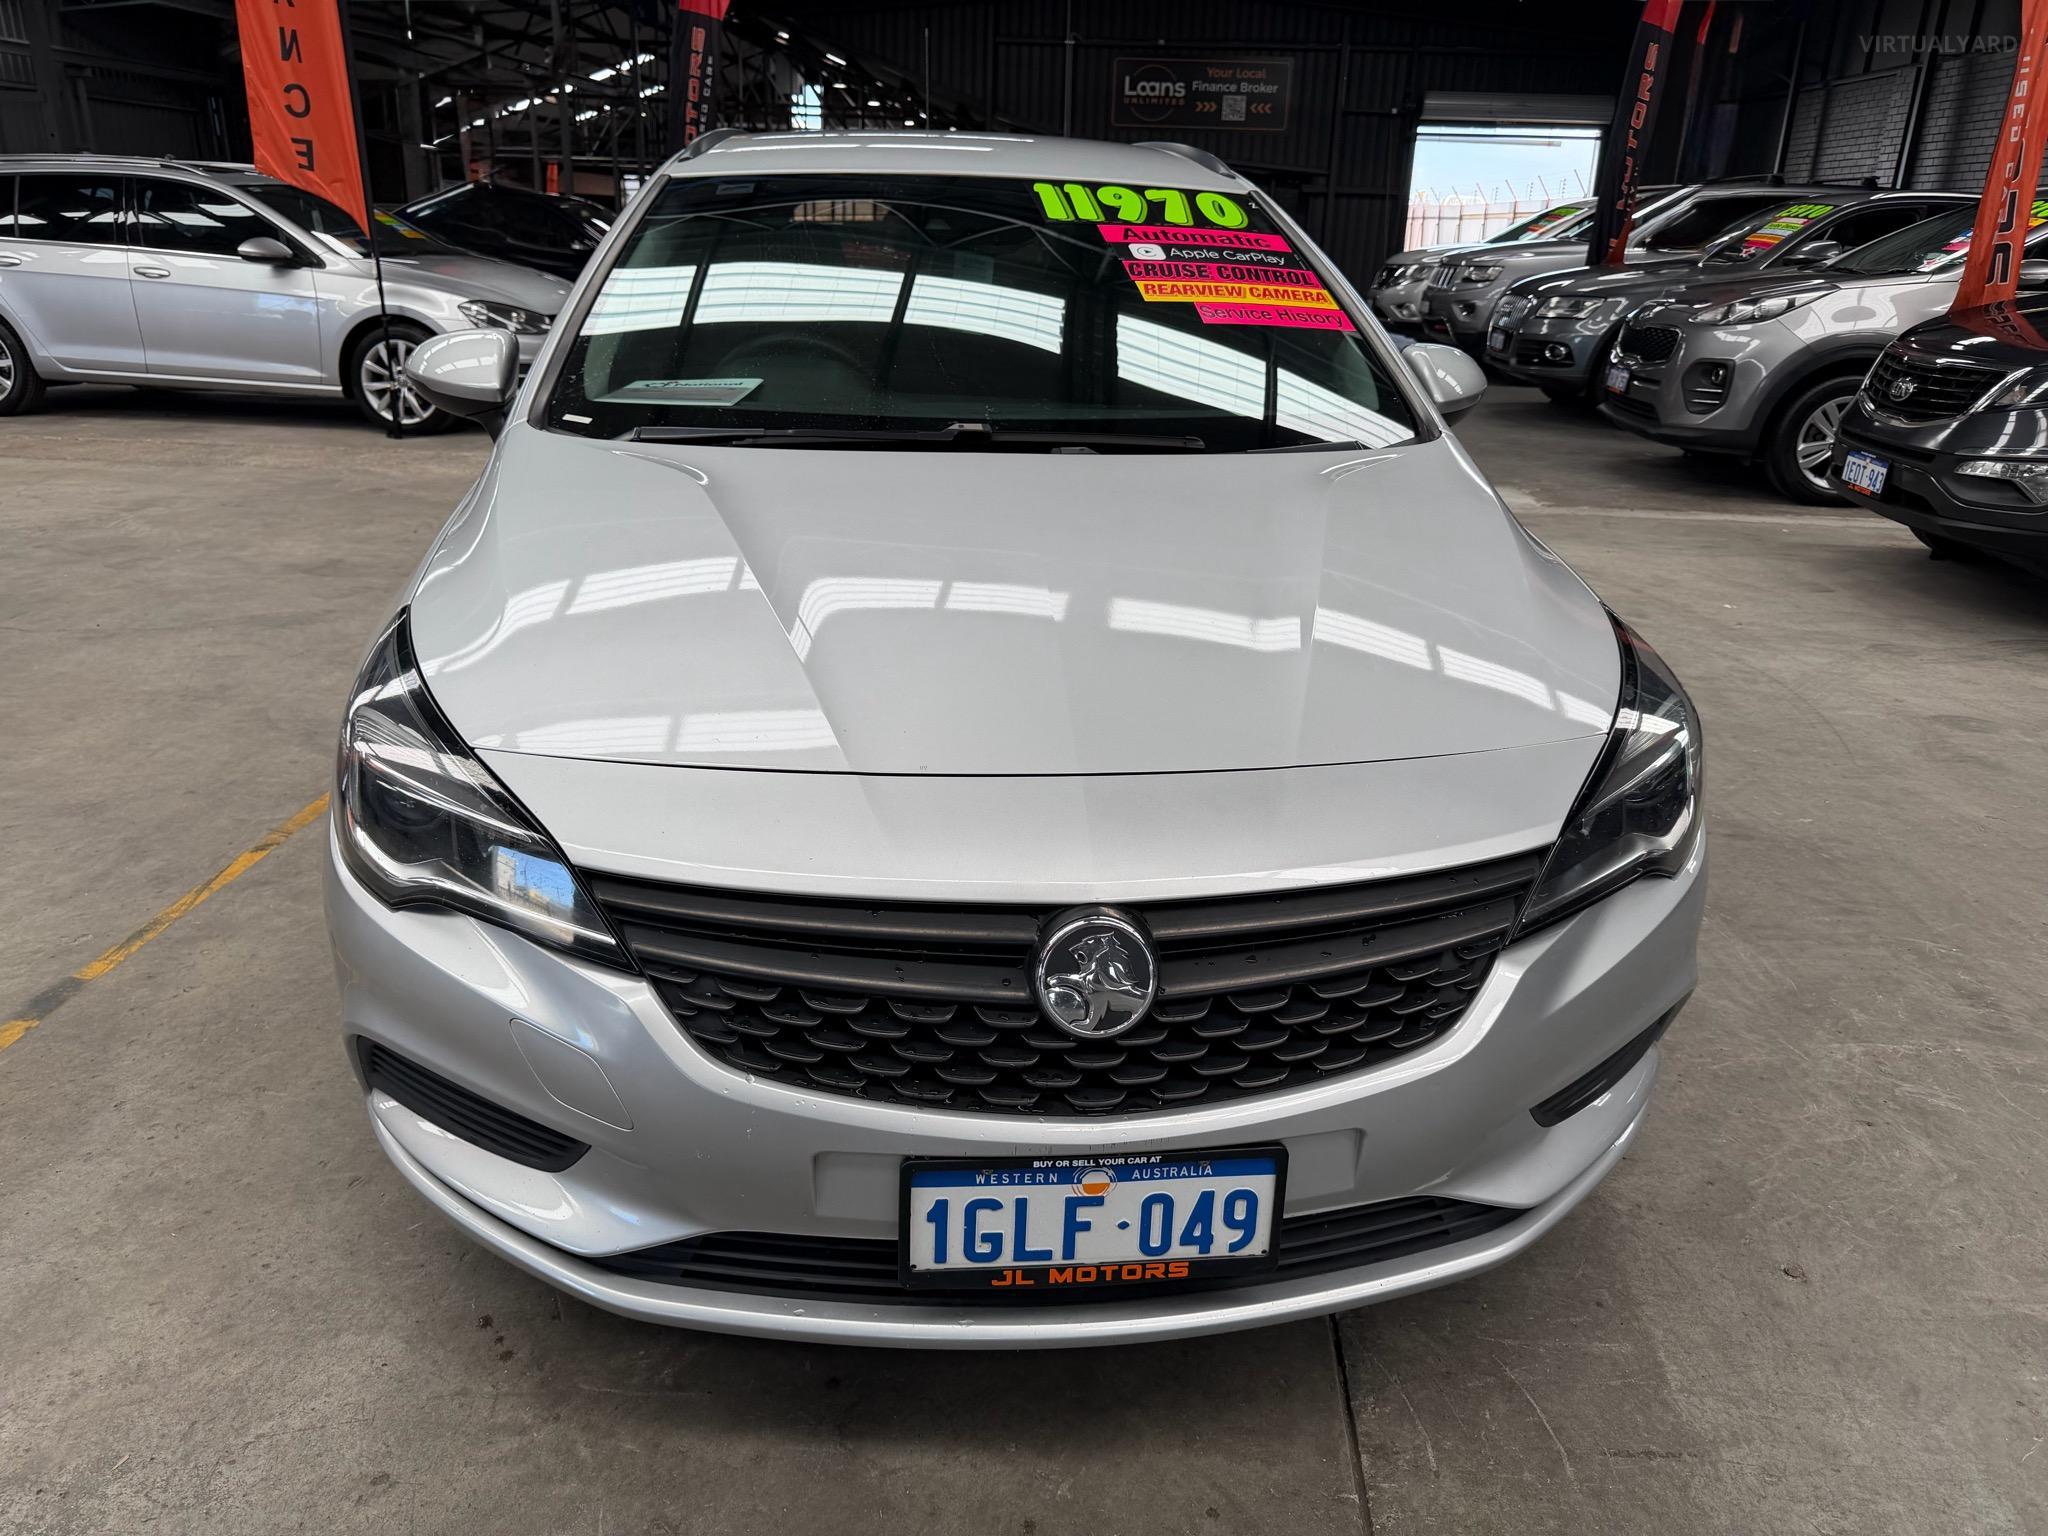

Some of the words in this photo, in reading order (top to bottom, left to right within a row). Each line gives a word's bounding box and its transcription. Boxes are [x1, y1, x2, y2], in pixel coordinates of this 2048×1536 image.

[1206, 67, 1233, 79] Your
[1236, 67, 1267, 79] Local
[1124, 75, 1186, 98] Loans
[1191, 80, 1237, 93] Finance
[1240, 82, 1279, 94] Broker
[1033, 182, 1248, 229] 11970
[1122, 227, 1272, 248] Automatic
[1170, 247, 1219, 261] Apple
[1223, 250, 1285, 266] CarPlay
[1128, 262, 1210, 279] CRUISE
[1217, 266, 1314, 286] CONTROL
[1144, 283, 1244, 298] REARVIEW
[1249, 287, 1328, 303] CAMERA
[1201, 305, 1273, 321] Service
[1277, 307, 1343, 327] History
[1033, 1160, 1053, 1168] BUY
[1072, 1159, 1096, 1167] SELL
[1098, 1158, 1125, 1166] YOUR
[1149, 1156, 1162, 1164] AT
[976, 1173, 1058, 1185] WESTERN
[1131, 1165, 1213, 1180] AUSTRALIA
[991, 1268, 1034, 1287] JL
[1049, 1261, 1190, 1284] MOTORS
